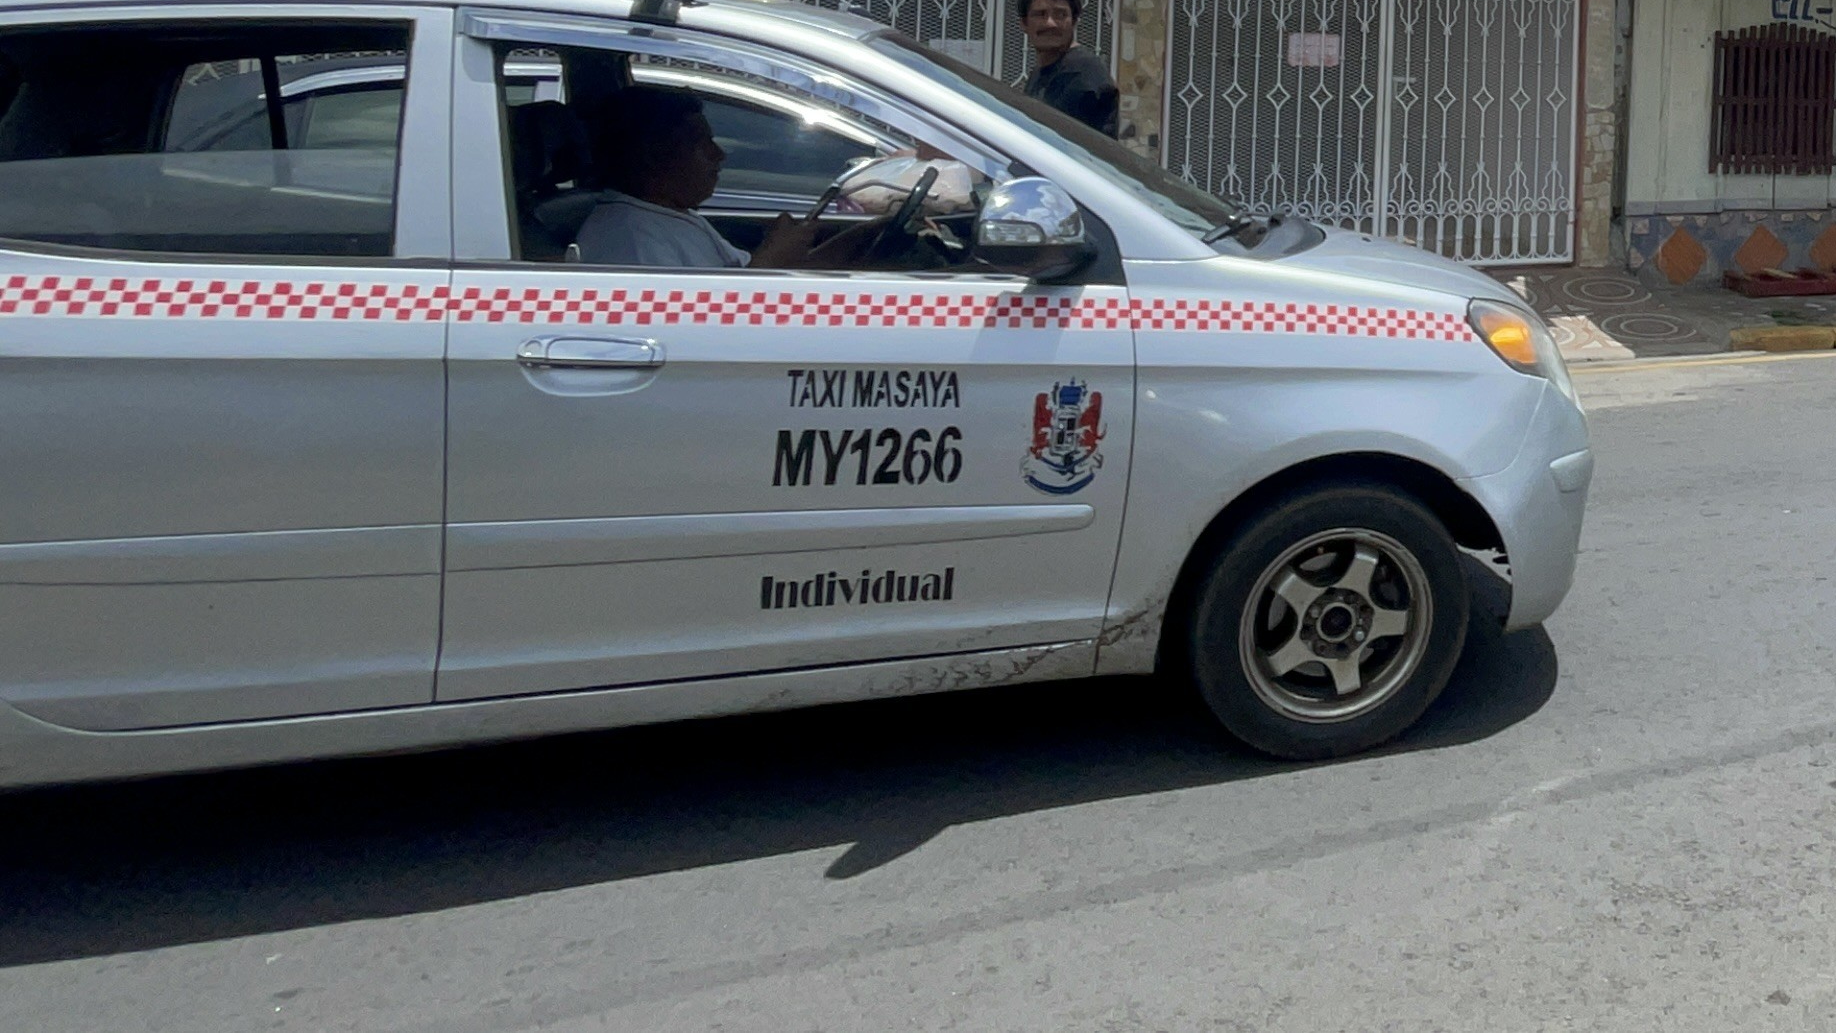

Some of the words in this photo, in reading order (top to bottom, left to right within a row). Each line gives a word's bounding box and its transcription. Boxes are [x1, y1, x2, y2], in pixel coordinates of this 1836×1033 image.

[788, 370, 847, 408] TAXI
[851, 369, 961, 408] MASAYA
[772, 426, 963, 487] MY1266
[760, 568, 955, 610] Individual
